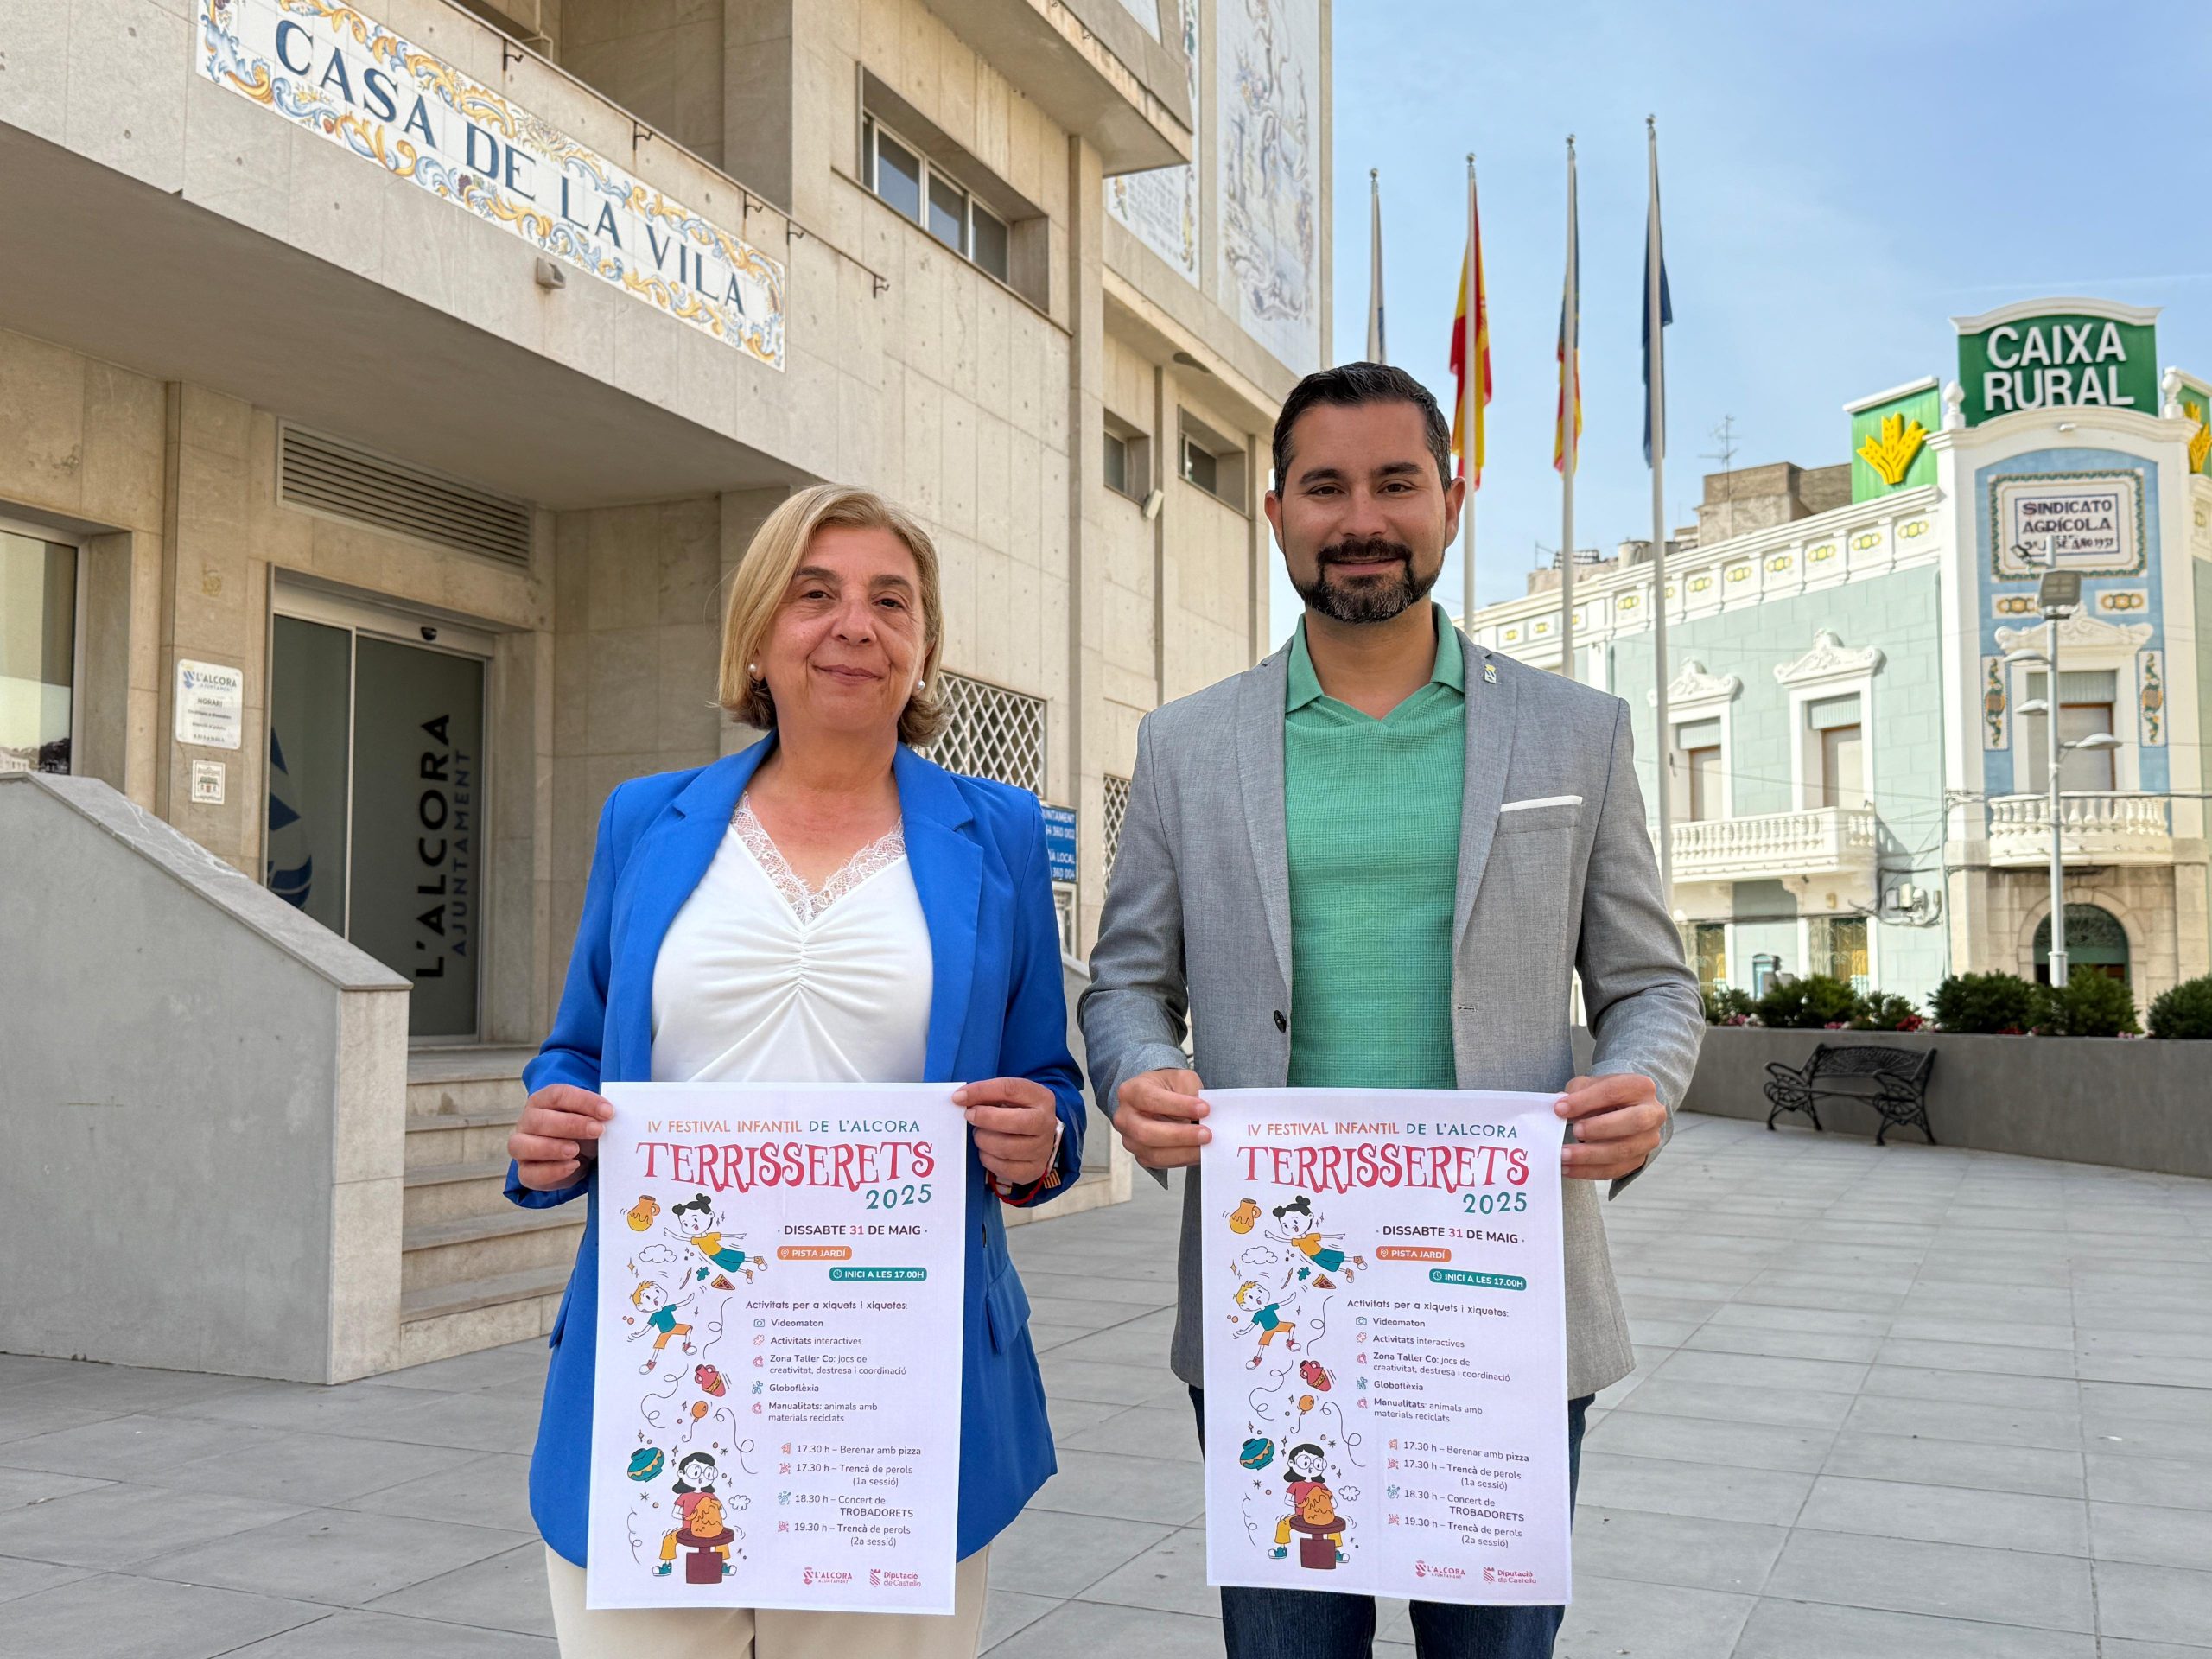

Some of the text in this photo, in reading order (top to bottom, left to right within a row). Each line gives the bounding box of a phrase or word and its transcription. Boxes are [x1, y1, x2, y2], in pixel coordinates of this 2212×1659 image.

[276, 19, 745, 315] CASA DE LA VILA
[1988, 321, 2126, 369] CAIXA
[1984, 365, 2134, 411] RURAL
[2023, 499, 2112, 515] SINDICATO
[2024, 517, 2112, 533] AGRÍCOLA
[196, 672, 237, 688] L'ALCORA
[197, 697, 223, 707] HORARI
[416, 714, 450, 978] L'ALCORA
[452, 749, 471, 957] AJUNTAMENT
[1057, 852, 1075, 865] LOCAL
[648, 1120, 919, 1133] IV FESTIVAL INFANTIL DE L'ALCORA
[1248, 1122, 1517, 1138] IV FESTIVAL INFANTIL DE L'ALCORA
[636, 1141, 935, 1193] TERRISSERETS
[1237, 1142, 1529, 1195] TERRISSERETS
[865, 1183, 931, 1211] 2025
[1462, 1192, 1528, 1214] 2025
[785, 1225, 920, 1235] DISSABTE 31 DE MAIG
[1383, 1225, 1517, 1243] DISSABTE 31 DE MAIG
[792, 1247, 846, 1259] PISTA JARDÍ
[1391, 1248, 1446, 1260] PISTA JARDÍ
[844, 1270, 925, 1279] INICI A LES 17.00H
[1444, 1272, 1465, 1281] INICI
[1476, 1274, 1492, 1284] LES
[1494, 1276, 1523, 1287] 17.00H
[793, 1302, 810, 1311] per
[823, 1301, 856, 1311] xiquets
[866, 1300, 908, 1311] xiquetes:
[1425, 1302, 1457, 1313] xiquets
[1467, 1306, 1509, 1317] xiquetes:
[1373, 1318, 1425, 1326] Videomaton
[1373, 1335, 1465, 1347] Activitats interactives
[837, 1355, 854, 1363] jocs
[1397, 1353, 1422, 1362] Taller
[1425, 1355, 1440, 1363] Co:
[1440, 1357, 1457, 1365] jocs
[1420, 1366, 1455, 1376] destresa
[1463, 1371, 1510, 1382] coordinació
[1374, 1381, 1423, 1390] Globoflèxia
[768, 1402, 822, 1410] Manualitats:
[1374, 1398, 1427, 1409] Manualitats:
[1430, 1403, 1461, 1412] animals
[1375, 1410, 1450, 1421] materials reciclats
[1404, 1442, 1428, 1451] 17.30
[1447, 1446, 1481, 1456] Berenar
[886, 1465, 912, 1474] perols
[1404, 1460, 1428, 1469] 17.30
[1447, 1464, 1477, 1474] Trencà
[1494, 1471, 1521, 1479] perols
[853, 1477, 898, 1487] (1a sessió)
[1461, 1478, 1507, 1491] (1a sessió)
[1405, 1490, 1429, 1499] 18.30
[1447, 1494, 1482, 1505] Concert
[841, 1508, 913, 1517] TROBADORETS
[1450, 1506, 1524, 1521] TROBADORETS
[884, 1526, 910, 1535] perols
[1405, 1517, 1429, 1527] 19.30
[1447, 1522, 1478, 1532] Trencà
[851, 1537, 896, 1548] (2a sessió)
[1462, 1535, 1508, 1548] (2a sessió)
[1427, 1566, 1465, 1575] L'ALCORA
